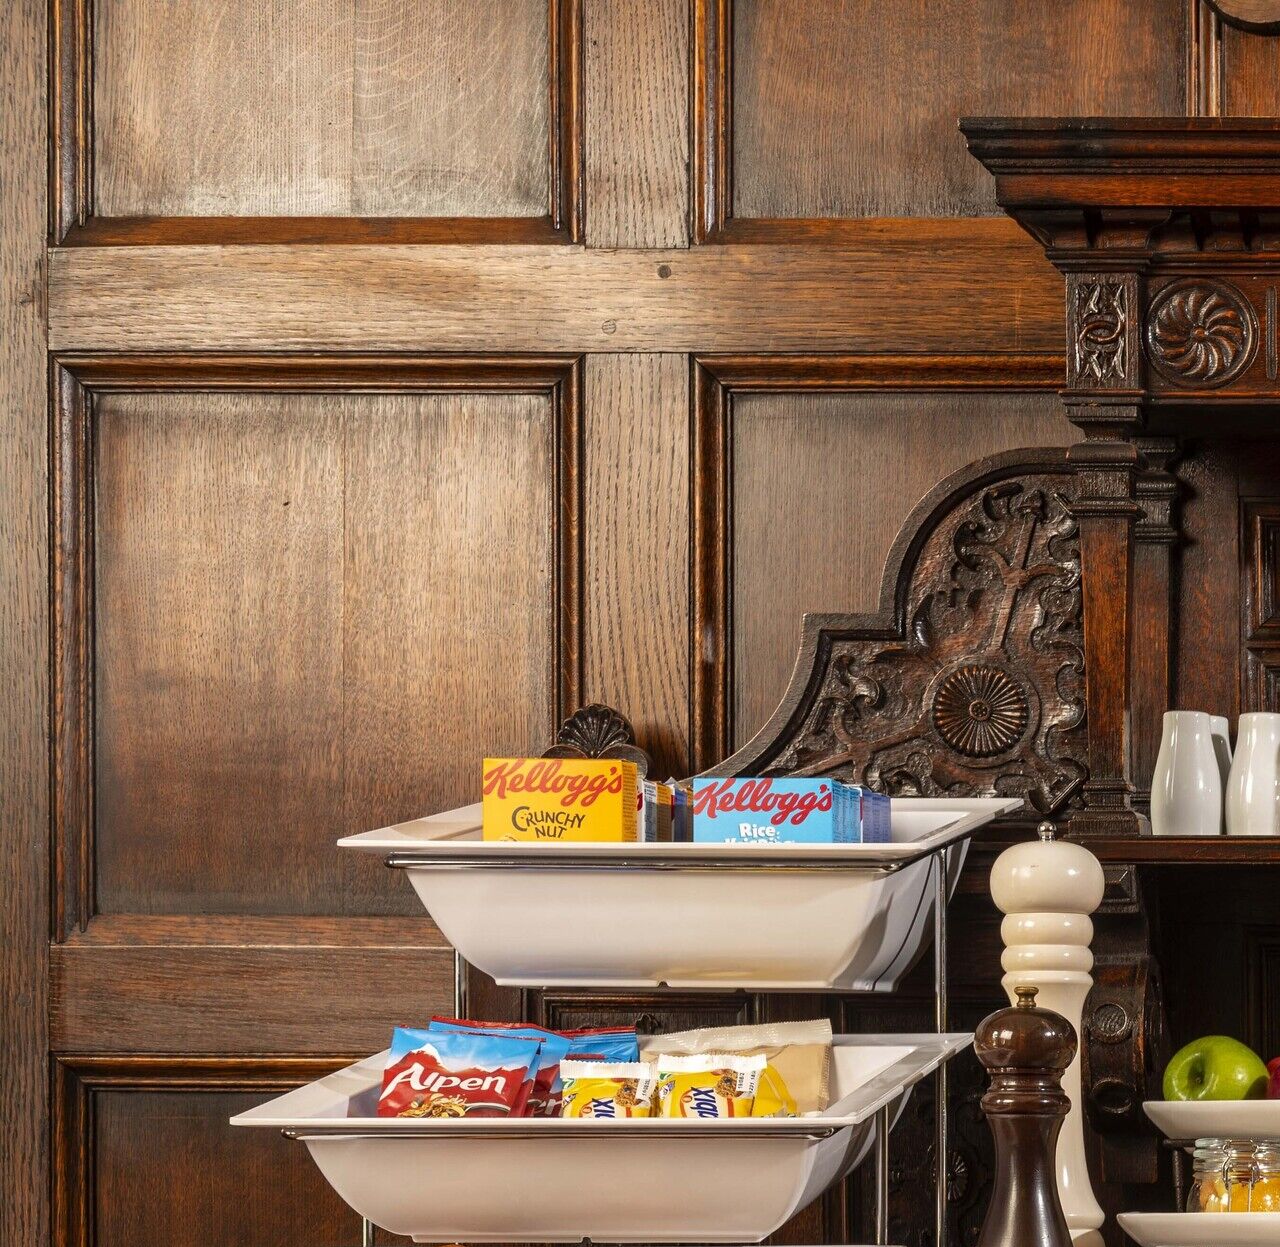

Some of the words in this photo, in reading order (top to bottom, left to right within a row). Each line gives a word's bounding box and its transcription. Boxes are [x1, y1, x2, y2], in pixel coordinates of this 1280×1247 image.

[483, 760, 622, 807] Kellogg's
[693, 777, 832, 825] Kellogg's
[511, 806, 586, 832] CRUNCHY
[535, 826, 567, 839] NUT
[739, 822, 776, 838] Rice
[379, 1062, 507, 1101] Alpen
